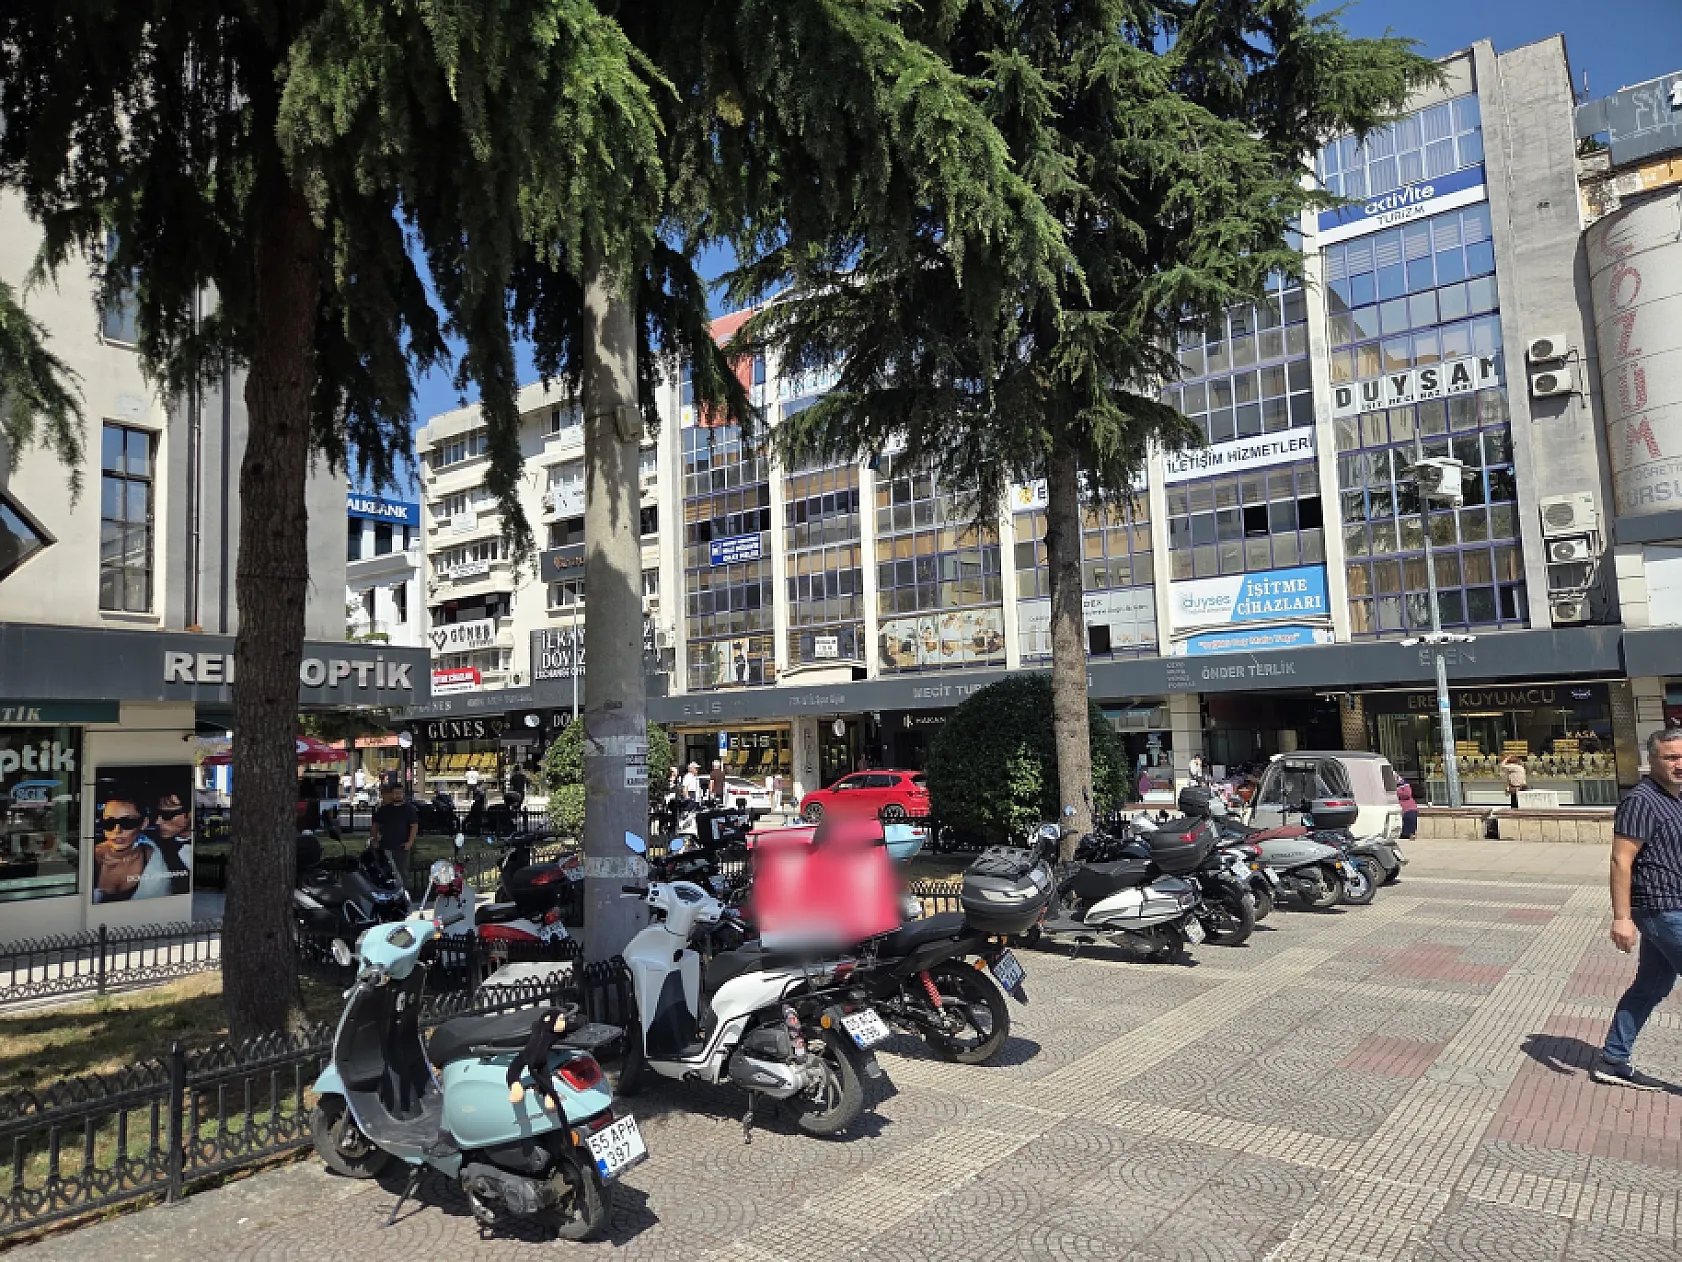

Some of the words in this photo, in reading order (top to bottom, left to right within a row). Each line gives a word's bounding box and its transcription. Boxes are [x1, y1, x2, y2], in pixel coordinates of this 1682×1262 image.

[1247, 577, 1308, 597] İŞİTME
[1237, 595, 1322, 616] CİHAZLARI
[1419, 647, 1477, 666] EEN
[300, 654, 413, 690] OPTİK
[1201, 665, 1245, 680] ÖNDER
[1247, 660, 1297, 677] TERLİK
[1408, 694, 1440, 709] ERE
[1458, 690, 1556, 707] KUYUMCU
